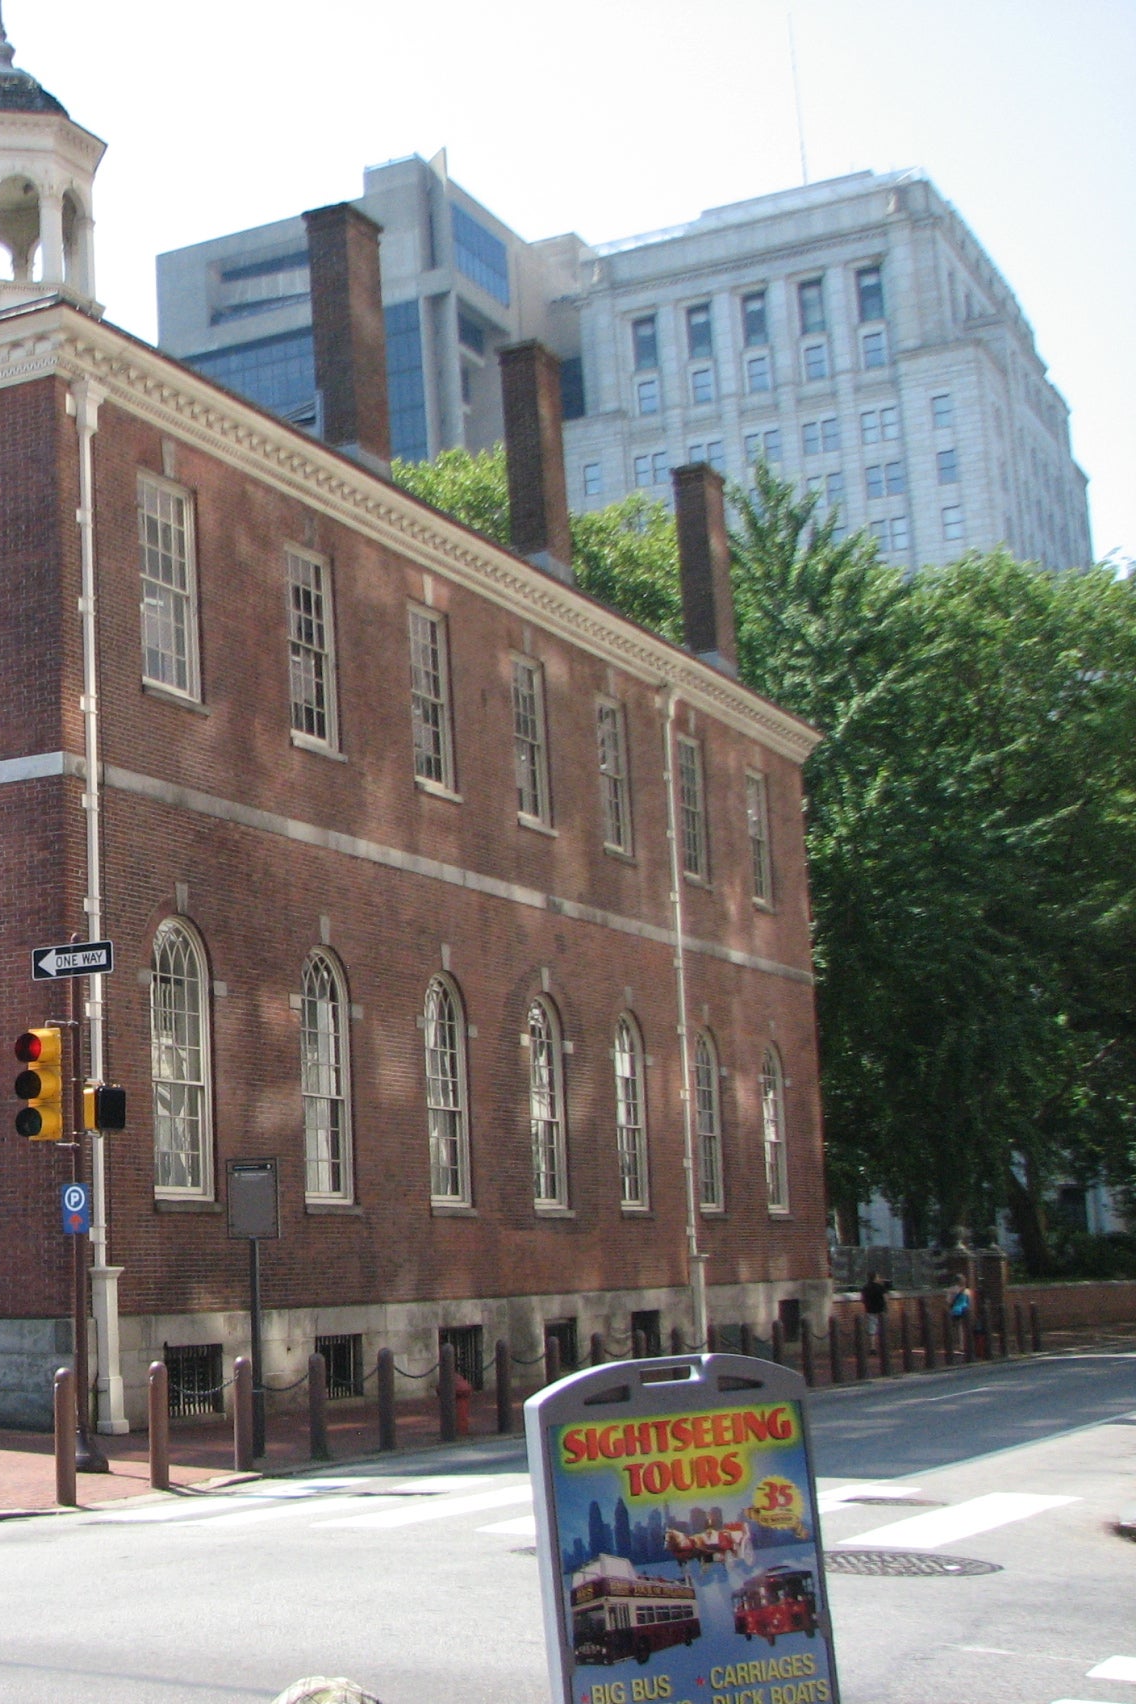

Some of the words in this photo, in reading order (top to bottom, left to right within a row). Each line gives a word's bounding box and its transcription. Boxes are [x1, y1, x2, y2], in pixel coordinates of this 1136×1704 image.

[55, 954, 79, 968] ONE
[82, 951, 103, 965] WAY
[70, 1191, 80, 1206] P
[563, 1407, 794, 1464] SIGHTSEEING
[623, 1452, 744, 1496] TOURS
[761, 1481, 794, 1511] 35
[710, 1652, 816, 1690] CARRIAGES
[591, 1683, 625, 1704] BIG
[631, 1674, 673, 1702] BUS
[770, 1679, 831, 1704] BOATS
